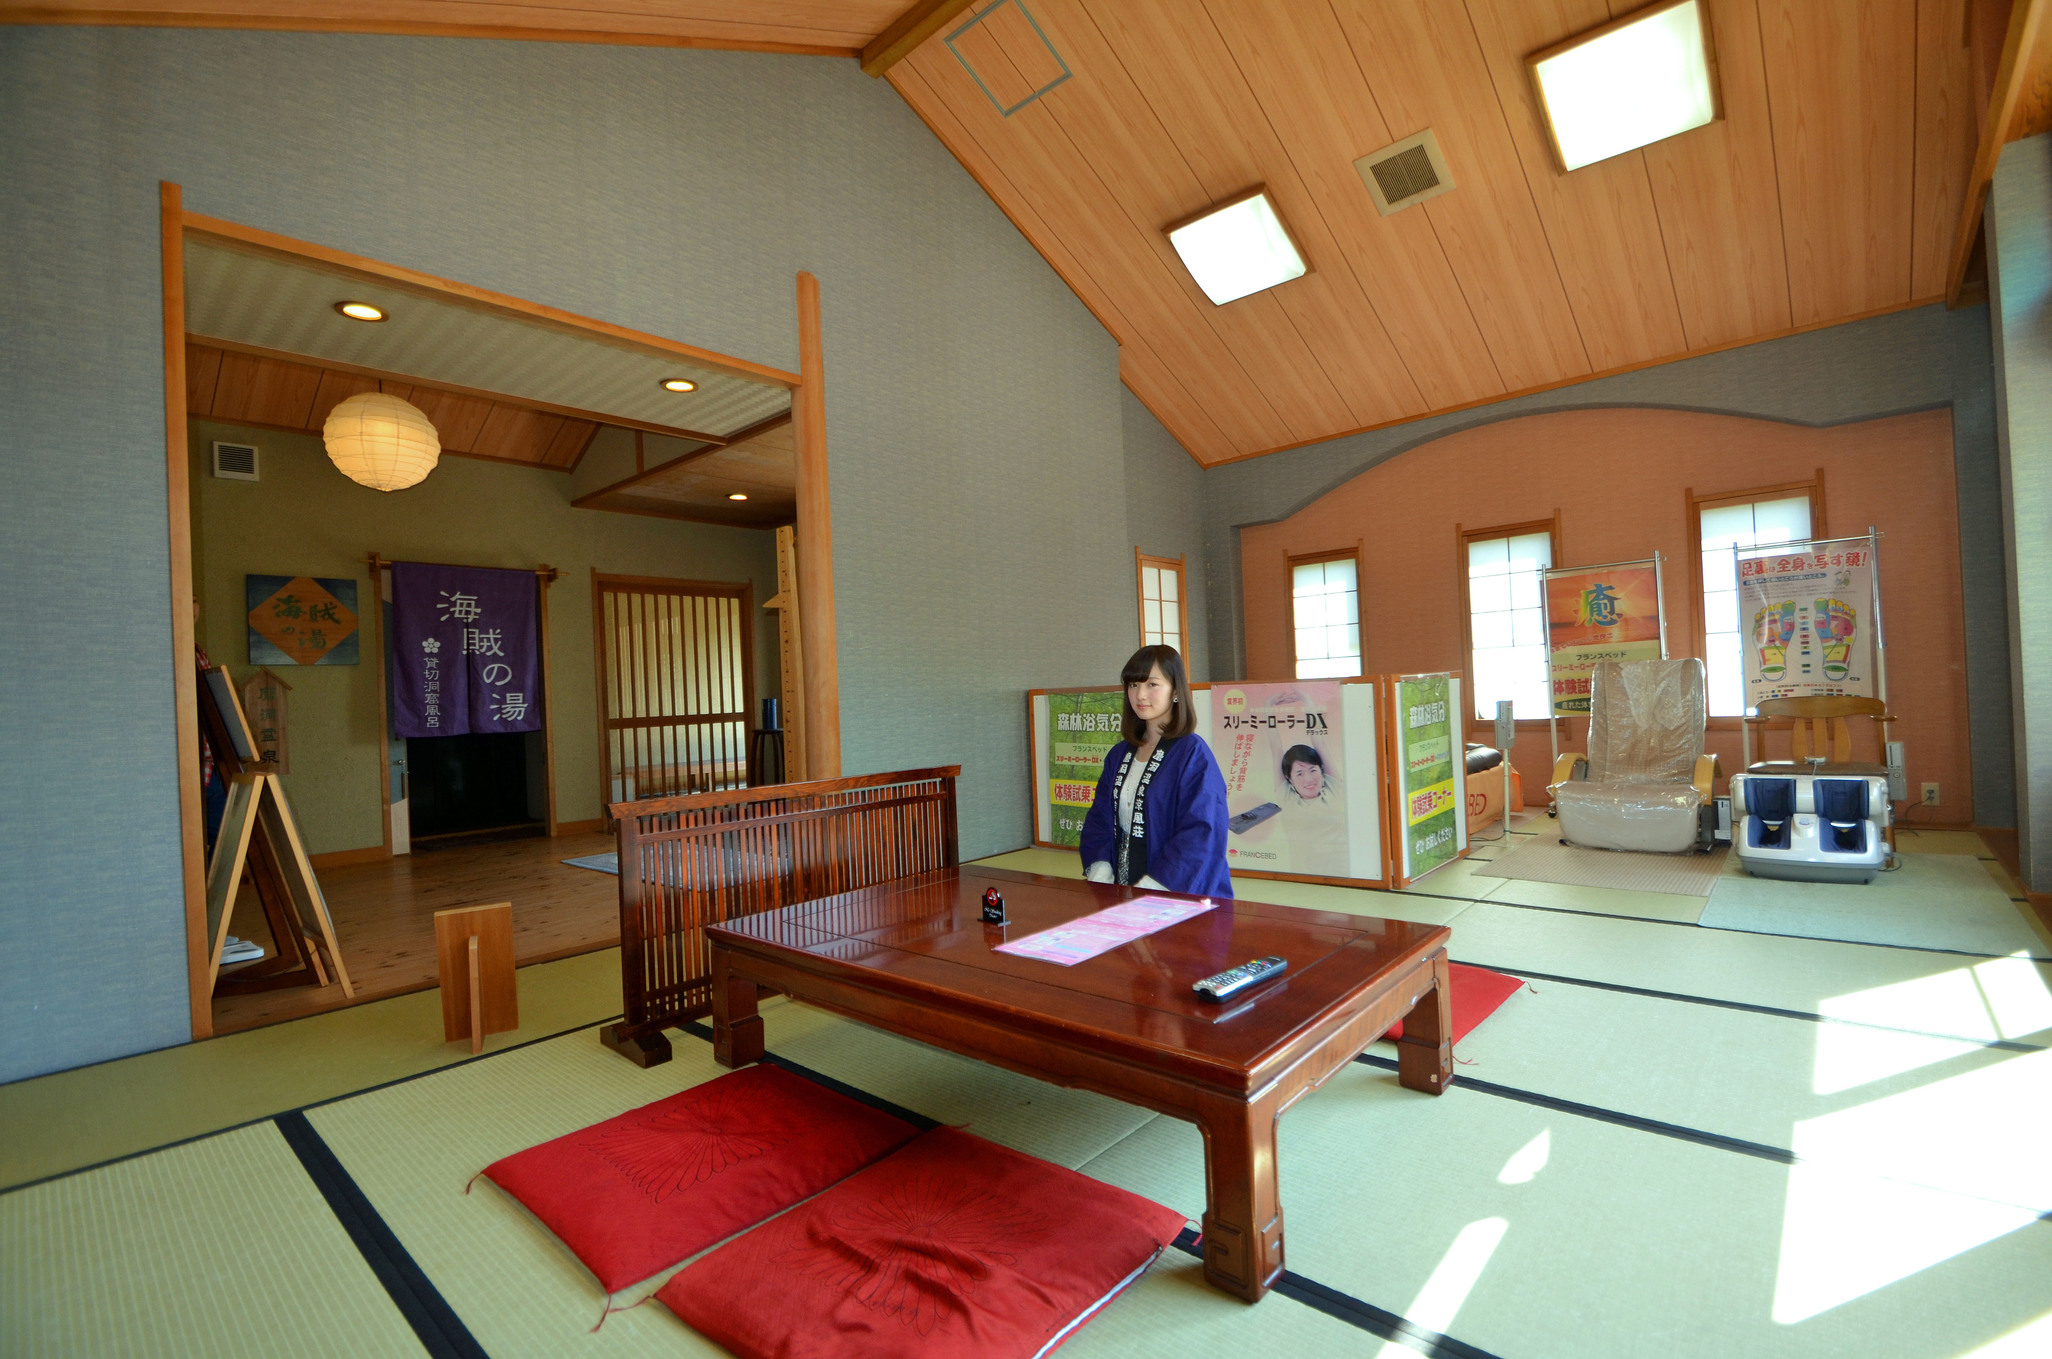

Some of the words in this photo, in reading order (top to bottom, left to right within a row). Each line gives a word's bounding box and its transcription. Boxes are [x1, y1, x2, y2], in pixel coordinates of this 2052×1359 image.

[1741, 552, 1868, 577] 足裏は全身を写す鏡!
[272, 594, 342, 624] 海賊
[1573, 583, 1624, 627] 癒
[436, 590, 528, 721] 海賊の湯
[1576, 651, 1627, 661] フランスベッド
[423, 657, 441, 728] 貸切洞窟風呂
[1553, 678, 1592, 696] 体験試
[1227, 697, 1243, 705] 業界初
[1057, 713, 1122, 732] 森林浴気分
[1224, 713, 1328, 729] スリーミーローラーDX
[1236, 734, 1255, 791] 寝ながら背筋を
[1467, 793, 1487, 816] BED
[1240, 851, 1277, 860] FRANCEBED
